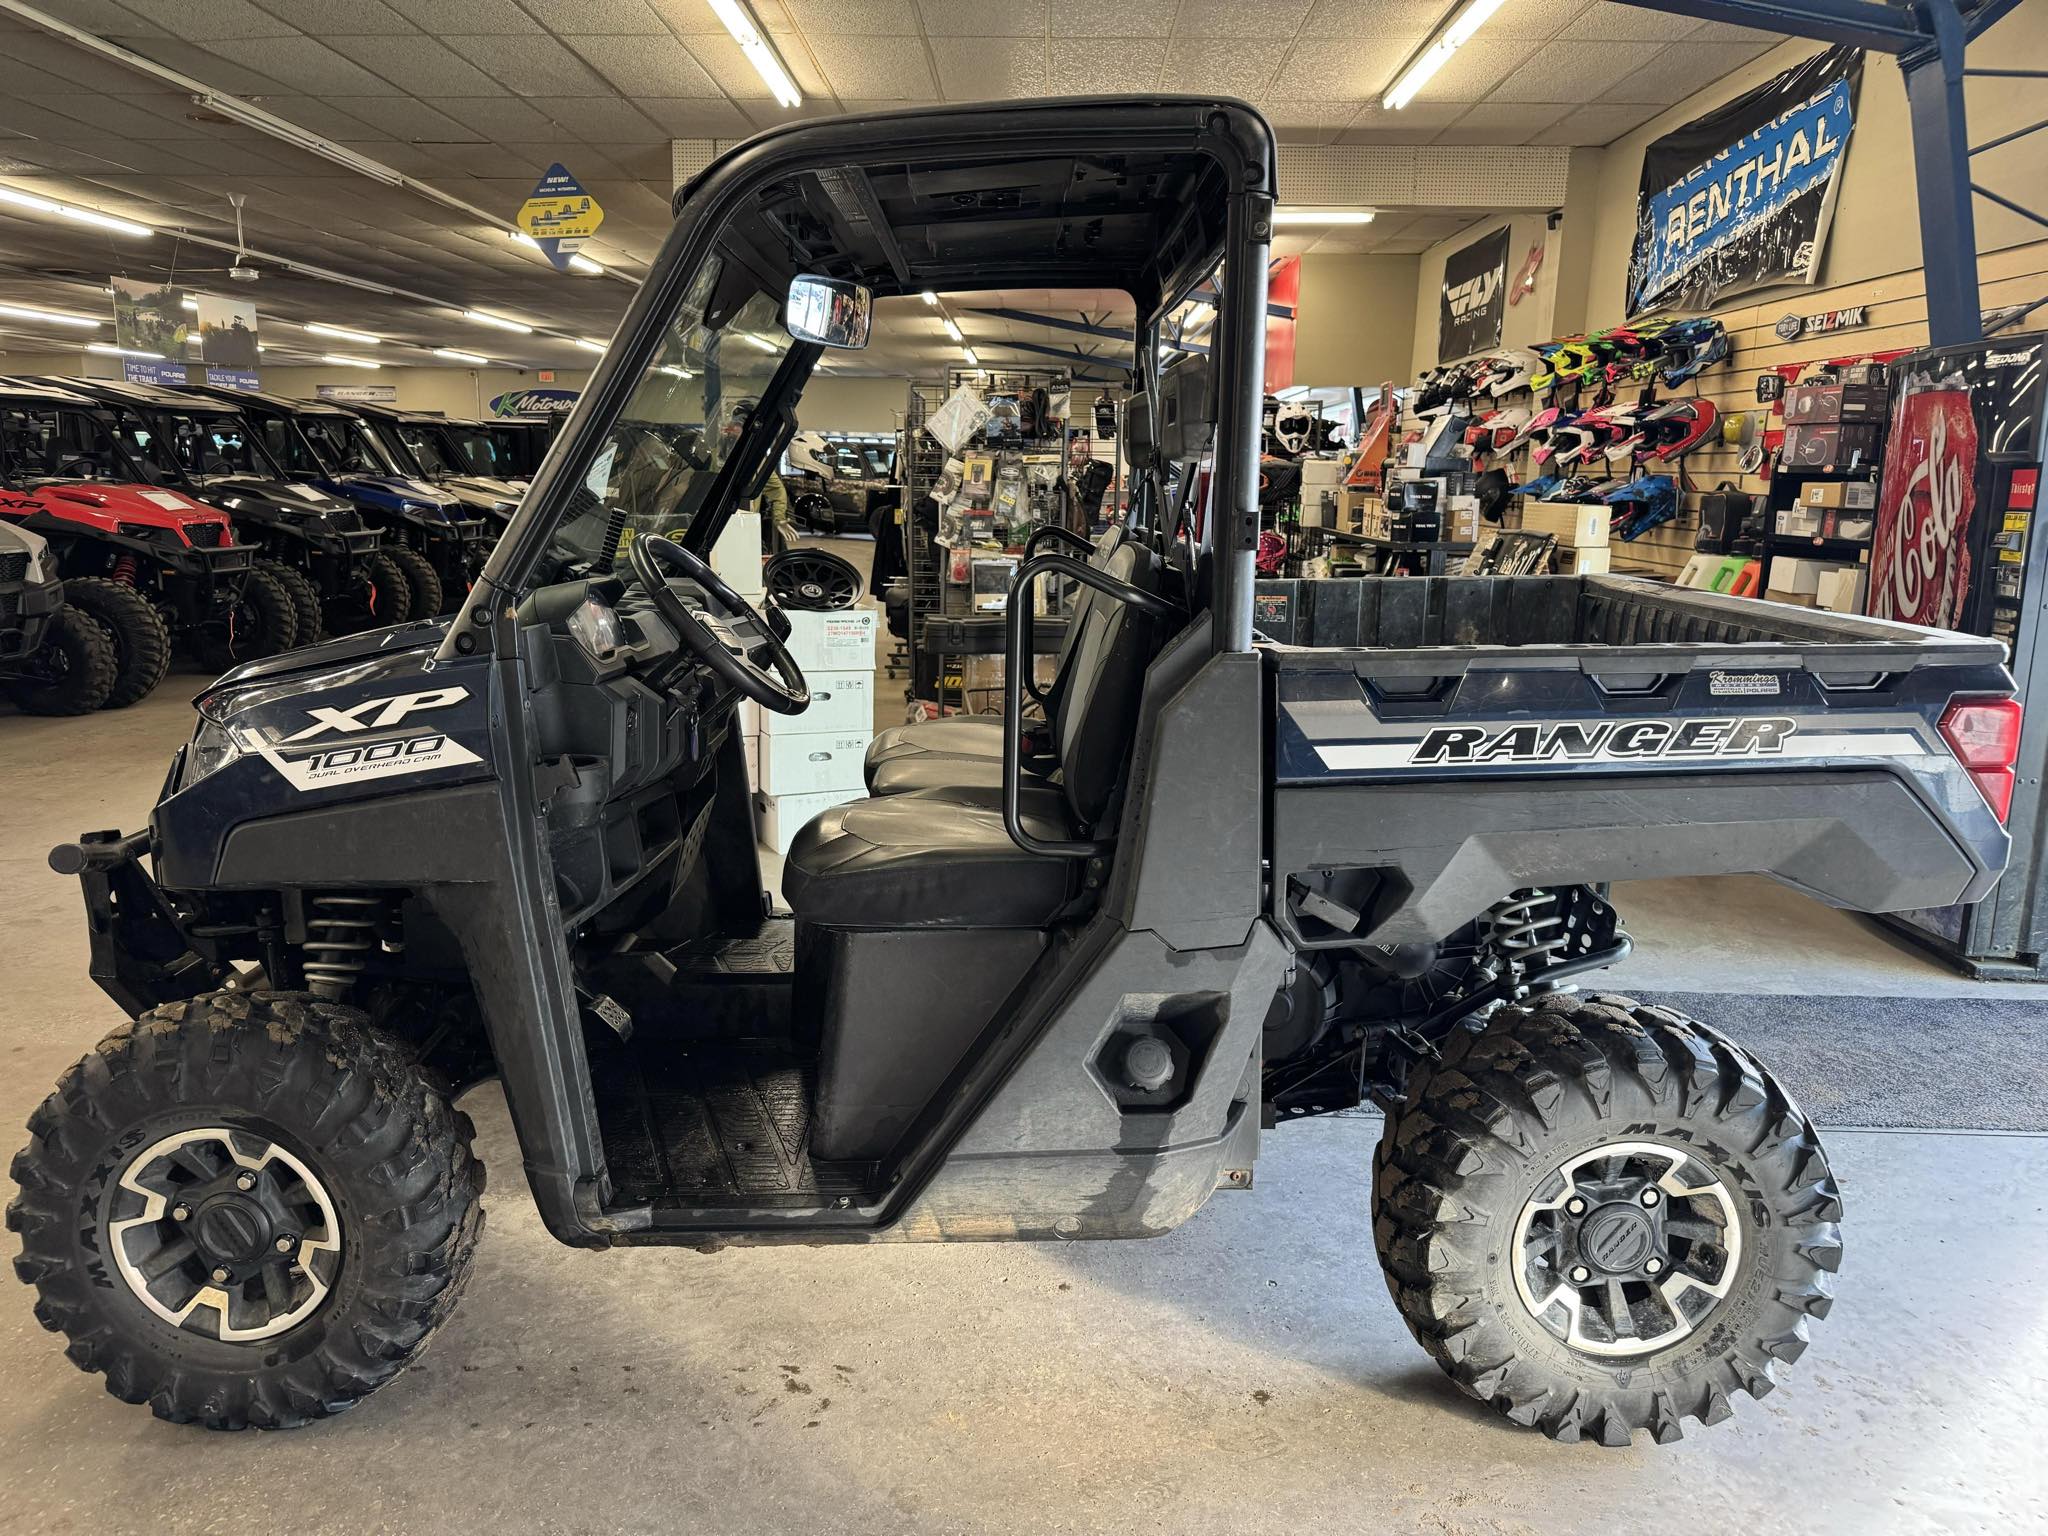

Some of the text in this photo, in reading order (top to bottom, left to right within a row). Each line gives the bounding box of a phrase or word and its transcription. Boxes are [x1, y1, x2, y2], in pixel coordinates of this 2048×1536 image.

[546, 176, 570, 184] NEW!
[1665, 115, 1841, 251] RENTHAL
[1446, 265, 1504, 317] FLY
[1453, 306, 1488, 328] RACING
[1804, 306, 1865, 333] SEIZMIK
[138, 374, 158, 384] TRAILS
[161, 370, 186, 379] POLARIS
[1894, 408, 1964, 618] Cola
[1710, 671, 1778, 686] Kromminga
[281, 686, 470, 742] XP
[307, 735, 447, 774] 1000
[1408, 717, 1797, 764] RANGER
[308, 753, 442, 780] DUAL OVERHEAD CAM
[1618, 1123, 1772, 1228] MAXXIS
[79, 1128, 146, 1289] MAXXIS
